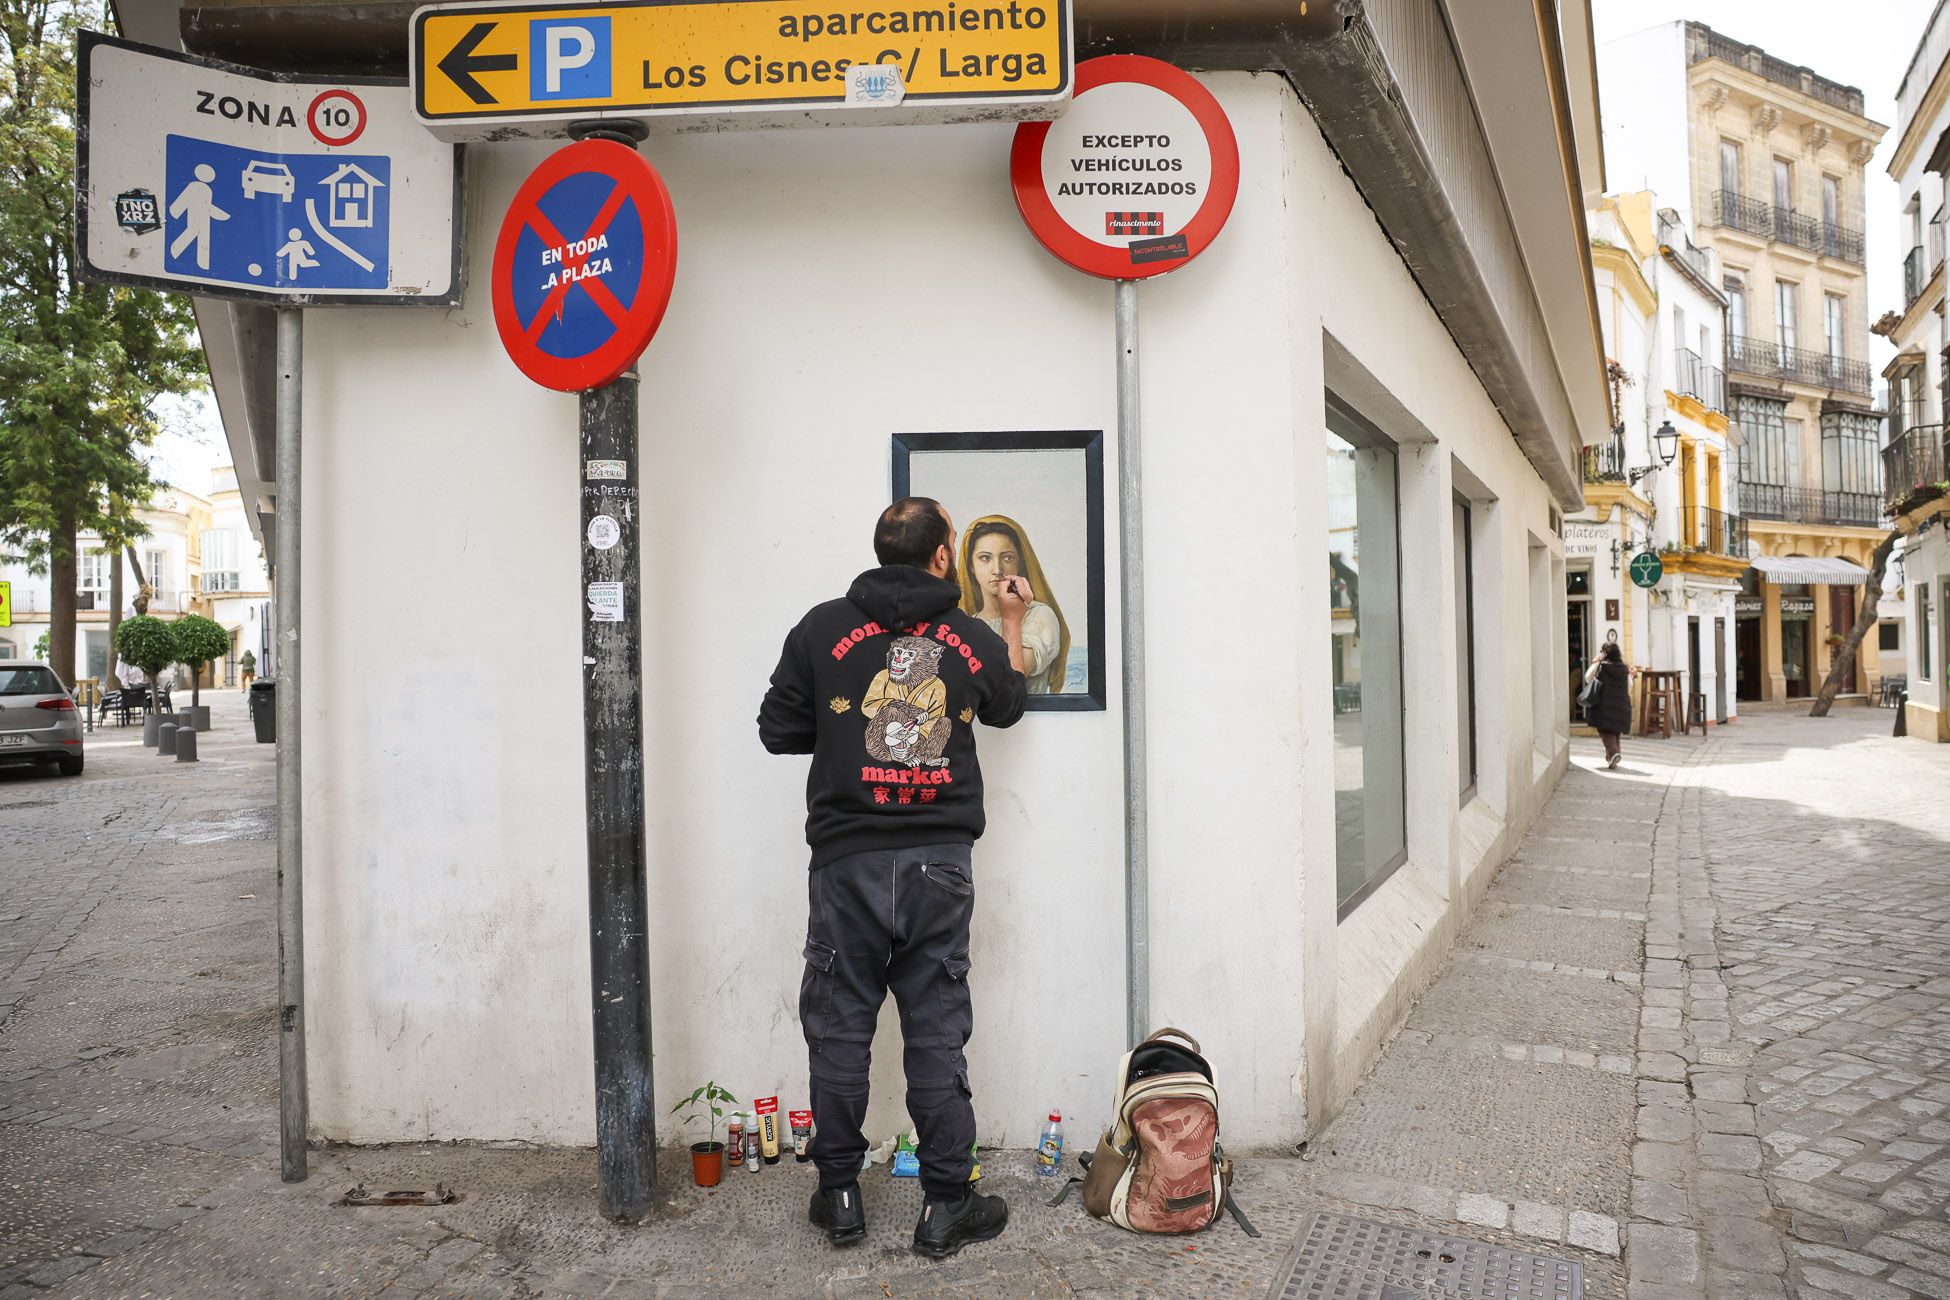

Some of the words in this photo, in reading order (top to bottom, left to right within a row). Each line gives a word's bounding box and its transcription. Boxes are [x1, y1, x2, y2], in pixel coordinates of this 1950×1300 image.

[778, 1, 1046, 42] aparcamiento
[545, 26, 596, 93] P
[642, 59, 707, 90] Los
[939, 48, 1047, 83] Larga
[196, 90, 297, 128] ZONA
[322, 107, 350, 127] 10
[1082, 134, 1171, 148] EXCEPTO
[1070, 155, 1183, 172] VEHÍCULOS
[1057, 182, 1197, 196] AUTORIZADOS
[119, 200, 154, 212] TNO
[121, 211, 156, 224] XRZ
[1109, 219, 1161, 227] rinascimento
[542, 246, 562, 266] EN
[566, 234, 608, 258] TODA
[562, 257, 613, 284] PLAZA
[1564, 525, 1610, 539] plateros
[1578, 545, 1598, 553] VINOS
[831, 621, 931, 661] mony
[934, 623, 983, 674] food
[8, 735, 24, 744] JZF
[861, 766, 953, 785] market
[873, 785, 937, 805] 家常菜
[765, 1116, 773, 1140] ACRYLIC
